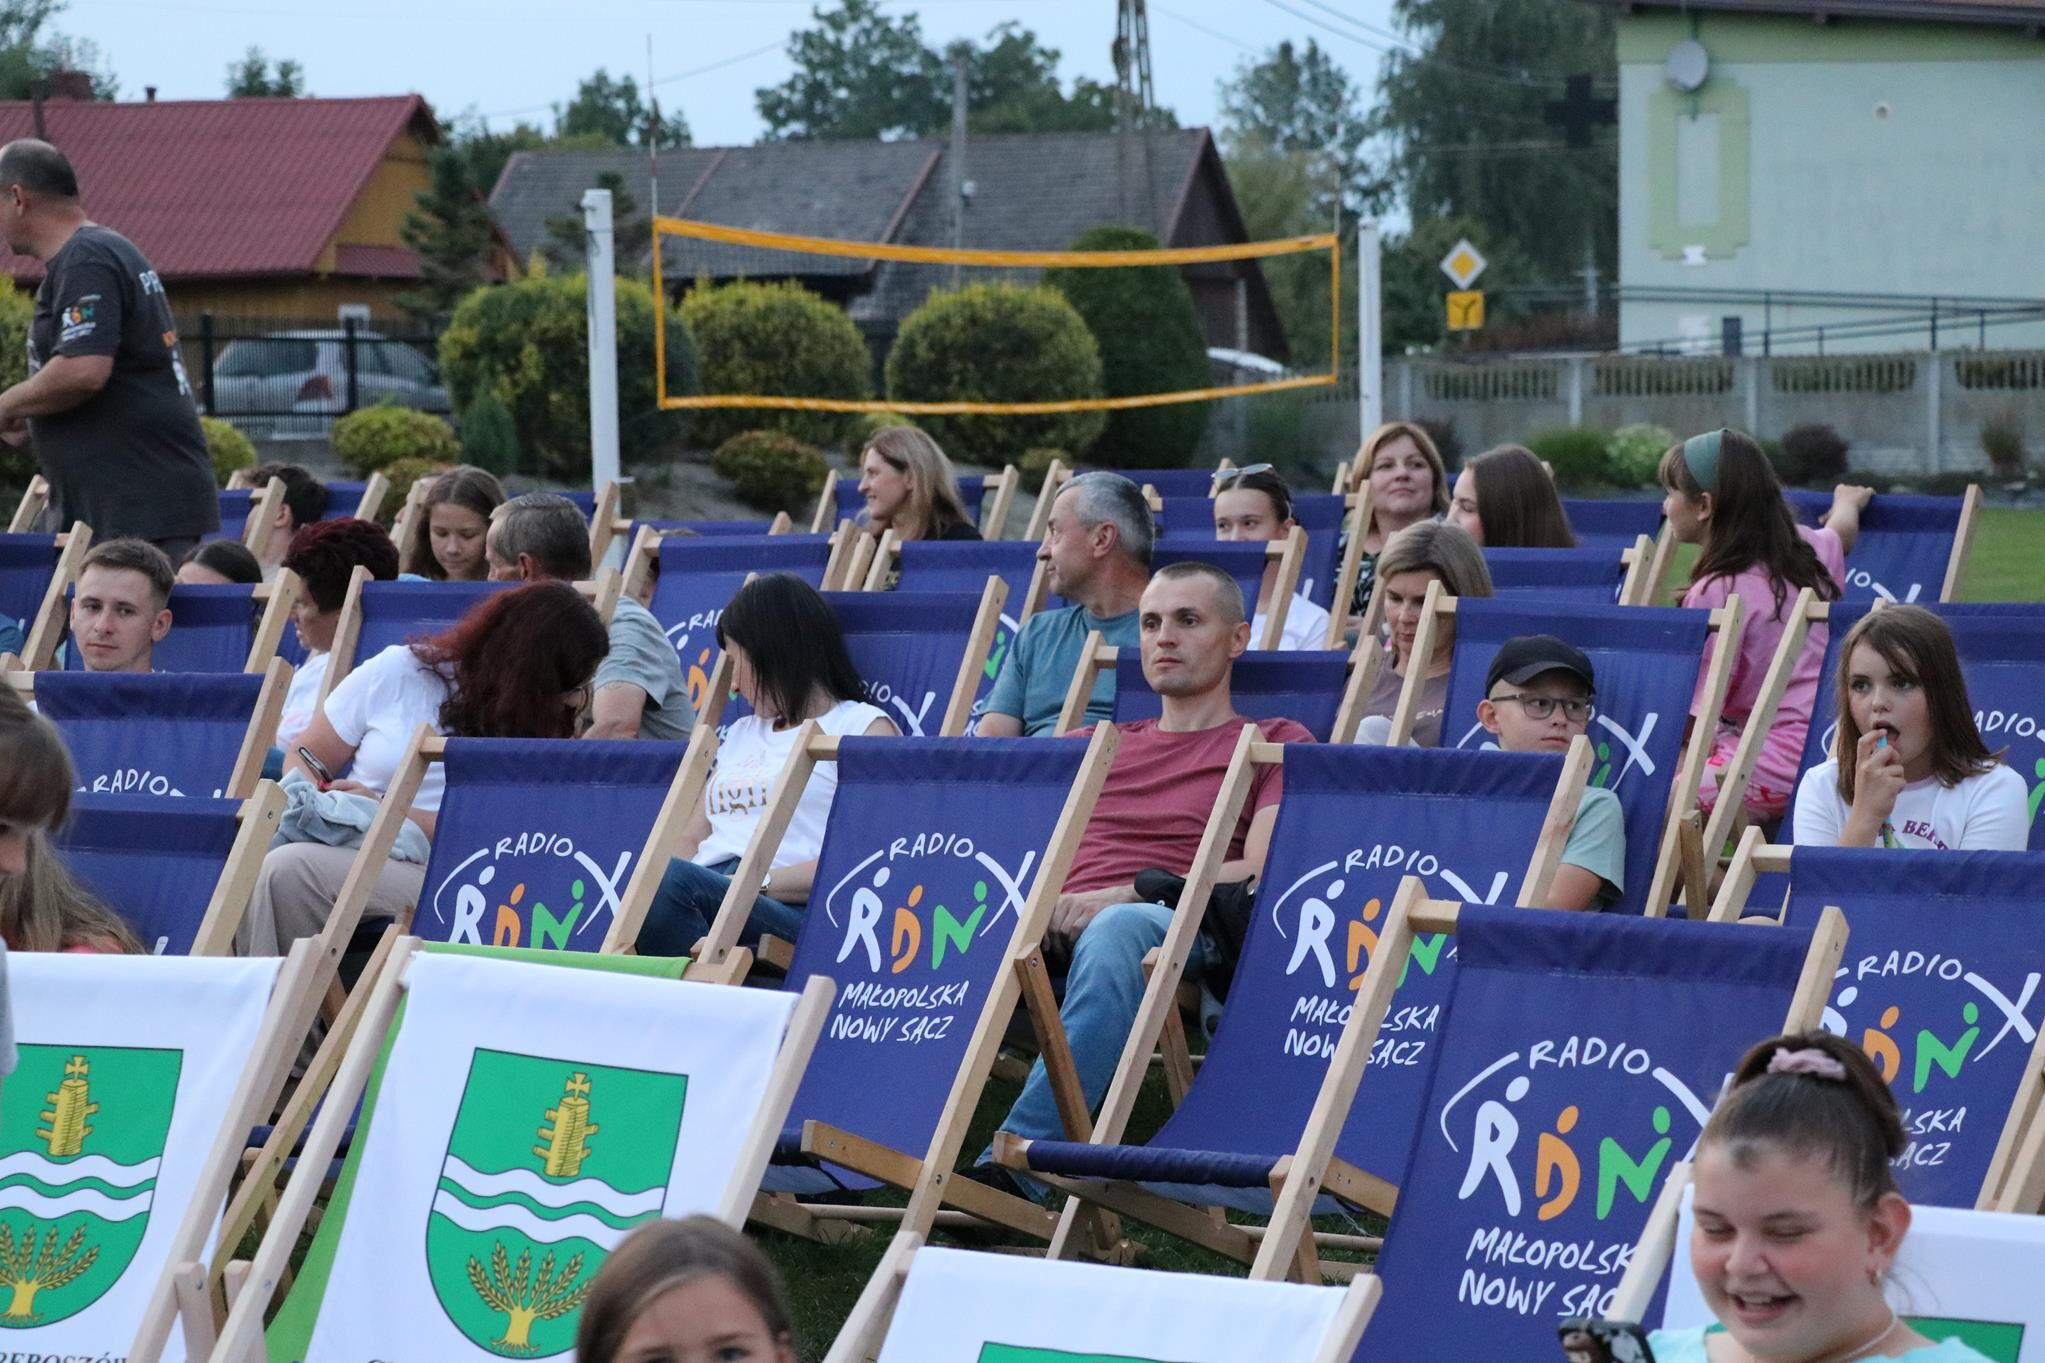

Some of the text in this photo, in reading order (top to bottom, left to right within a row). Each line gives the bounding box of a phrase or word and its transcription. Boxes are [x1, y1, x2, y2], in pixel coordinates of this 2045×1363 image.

[1973, 710, 2036, 738] ADIO
[93, 768, 169, 796] RADIO
[495, 832, 574, 861] RADIO
[889, 832, 974, 861] RADIO
[1344, 844, 1439, 876] RADIO
[836, 866, 988, 975] RDN
[1857, 950, 1963, 981] RADIO
[838, 980, 970, 1010] MAŁOPOLSKA
[830, 1013, 955, 1045] NOWY SĄCZ
[1290, 995, 1441, 1032] MAŁOLSKA
[1529, 1036, 1651, 1075] RADIO
[1457, 1075, 1673, 1222] RDN
[1465, 1226, 1638, 1275] MAŁOPOLSK
[1458, 1268, 1557, 1316] NOWY
